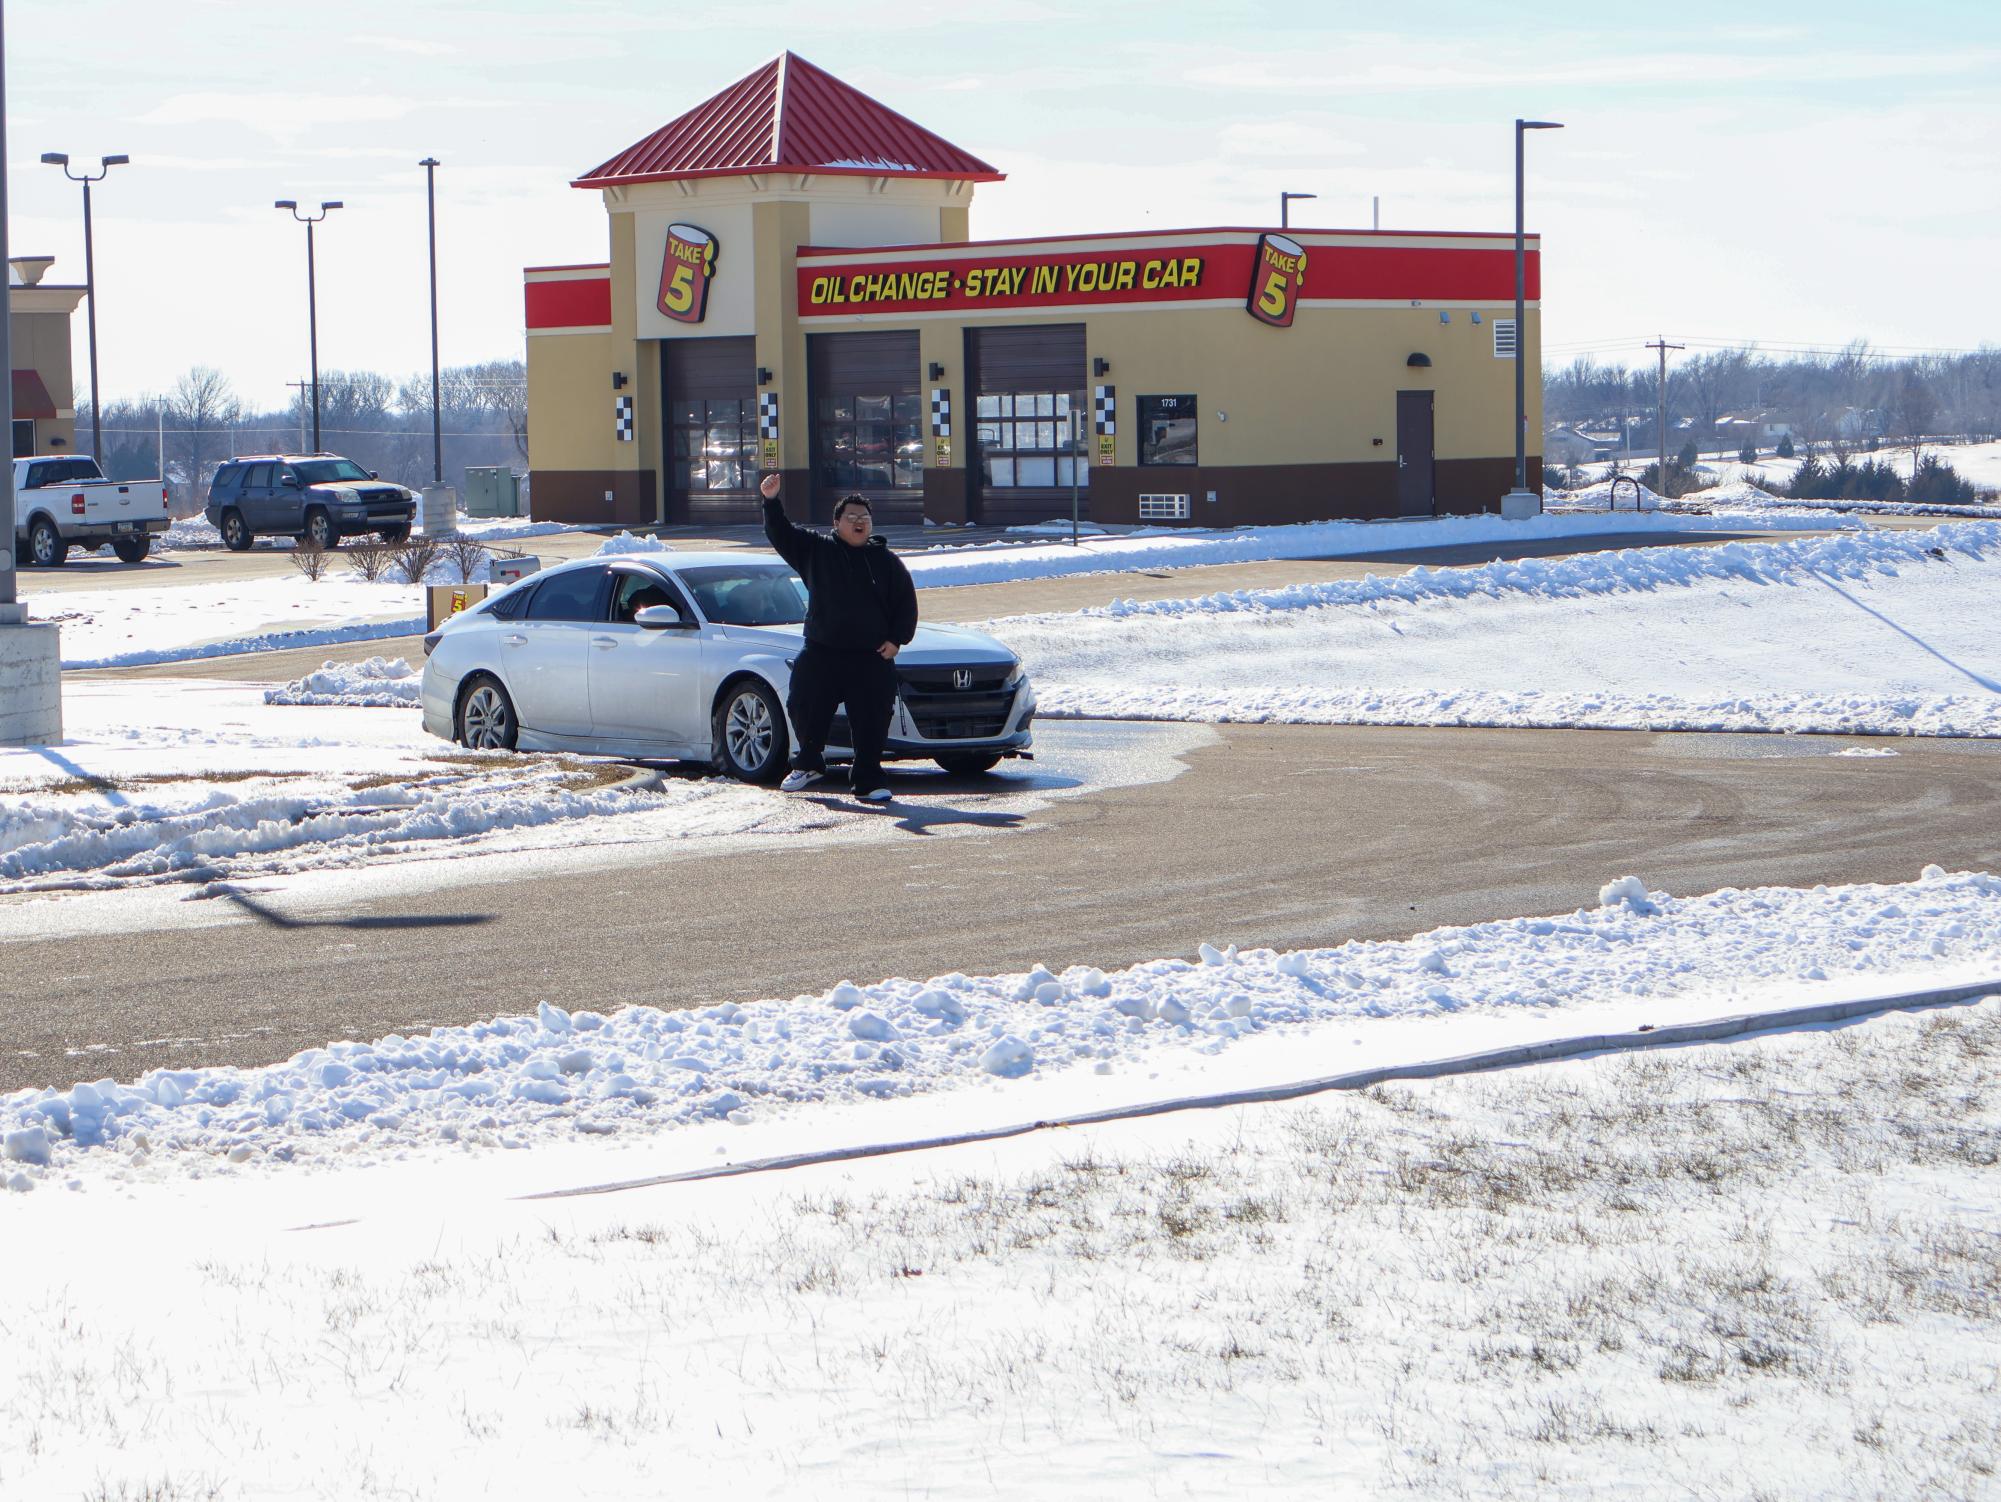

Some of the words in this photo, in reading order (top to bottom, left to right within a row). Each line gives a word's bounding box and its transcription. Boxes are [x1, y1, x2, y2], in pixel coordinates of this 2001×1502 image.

[669, 237, 702, 264] TAKE
[1263, 245, 1296, 272] TAKE
[664, 264, 694, 312] 5
[810, 276, 845, 304] OIL
[849, 271, 950, 303] CHANGE
[965, 266, 1027, 297] STAY
[1031, 265, 1059, 294] IN
[1066, 261, 1137, 292] YOUR
[1142, 258, 1201, 289] CAR
[1258, 271, 1287, 316] 5
[1161, 398, 1177, 407] 1731
[452, 600, 463, 611] 5
